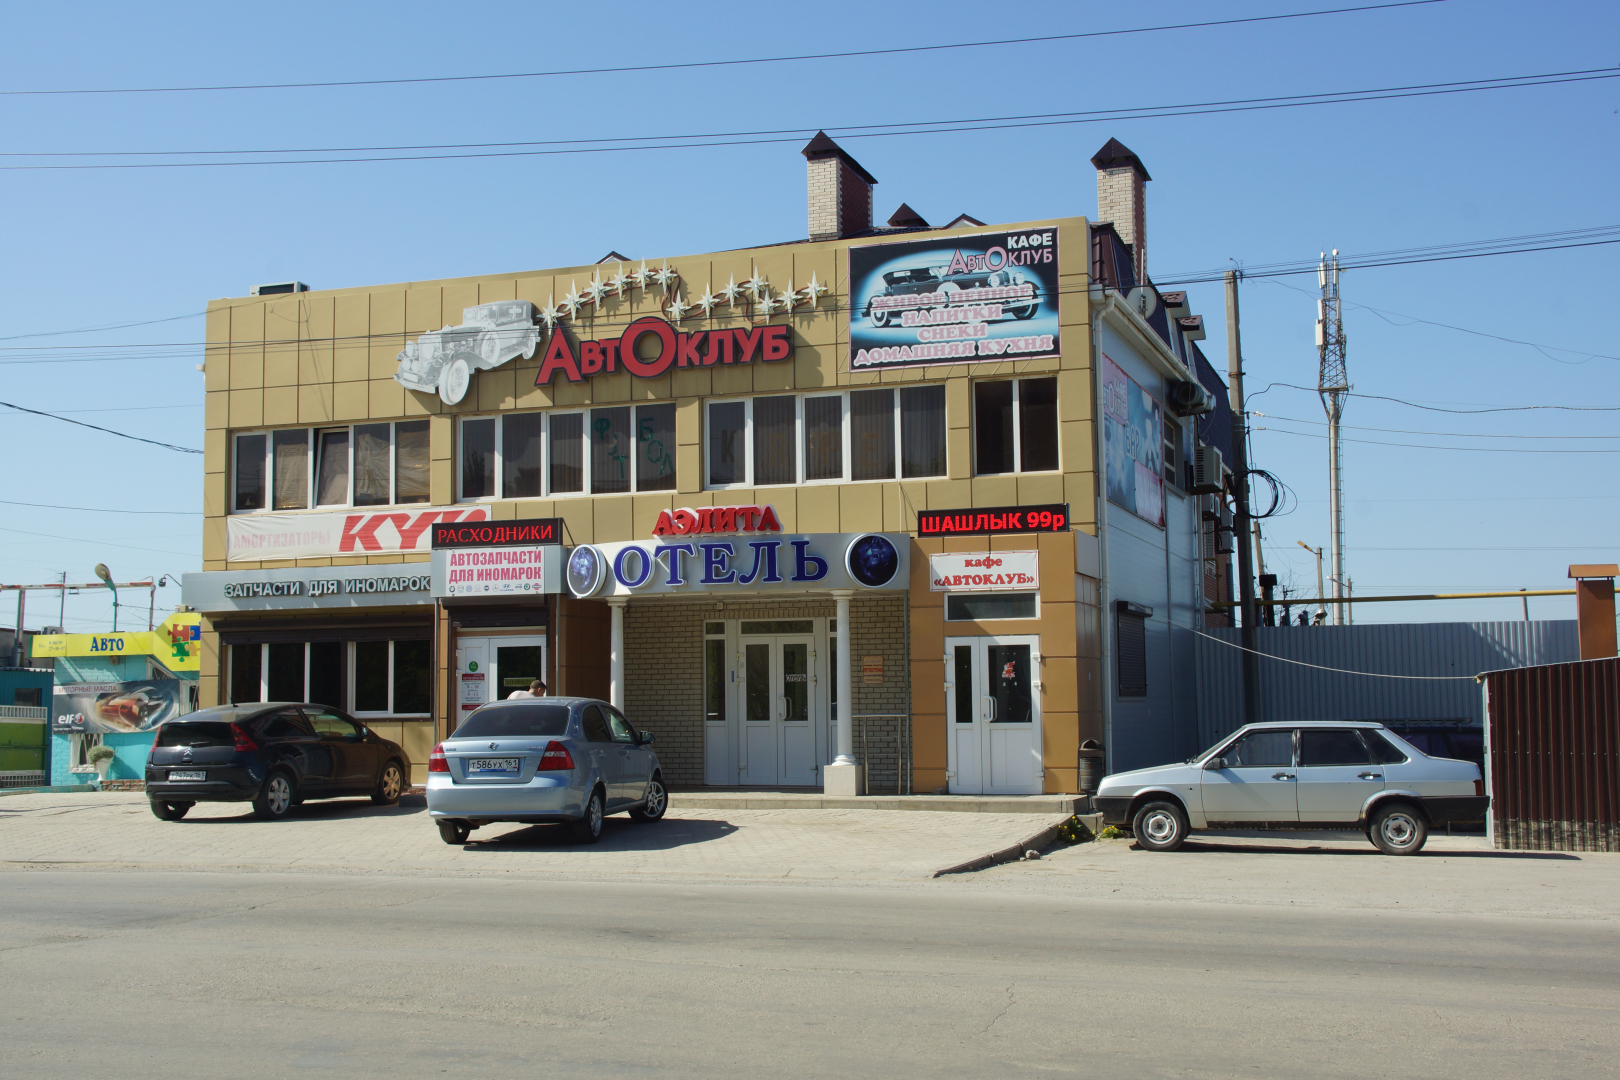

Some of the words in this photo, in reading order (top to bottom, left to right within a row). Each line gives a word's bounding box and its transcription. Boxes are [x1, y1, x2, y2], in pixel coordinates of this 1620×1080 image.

[1008, 233, 1052, 249] КАФЕ
[872, 292, 945, 311] ЖИВОЕ
[950, 284, 1032, 302] ПЕННОЕ
[902, 305, 1001, 326] НАПИТКИ
[918, 322, 987, 341] СНЕКИ
[854, 341, 976, 365] ДОМАШНЯЯ
[979, 335, 1054, 354] КУХНЯ
[653, 504, 783, 536] АЭЛИТА
[921, 512, 1022, 533] ШАШЛЫК
[233, 530, 331, 549] АМОРТИЗАТОРЫ
[437, 524, 553, 544] РАСХОДНИКИ
[450, 550, 542, 567] АВТОЗАПЧАСТИ
[613, 540, 829, 588] ОТЕЛЬ
[964, 556, 1003, 569] кафе
[449, 569, 475, 584] ДЛЯ
[477, 567, 542, 581] ИНОМАРОК
[934, 573, 1035, 587] «АВТОКЛУБ»
[224, 581, 300, 598] ЗАПЧАСТИ
[308, 579, 338, 596] ДЛЯ
[345, 576, 431, 594] ИНОМАРОК
[58, 714, 75, 724] elf
